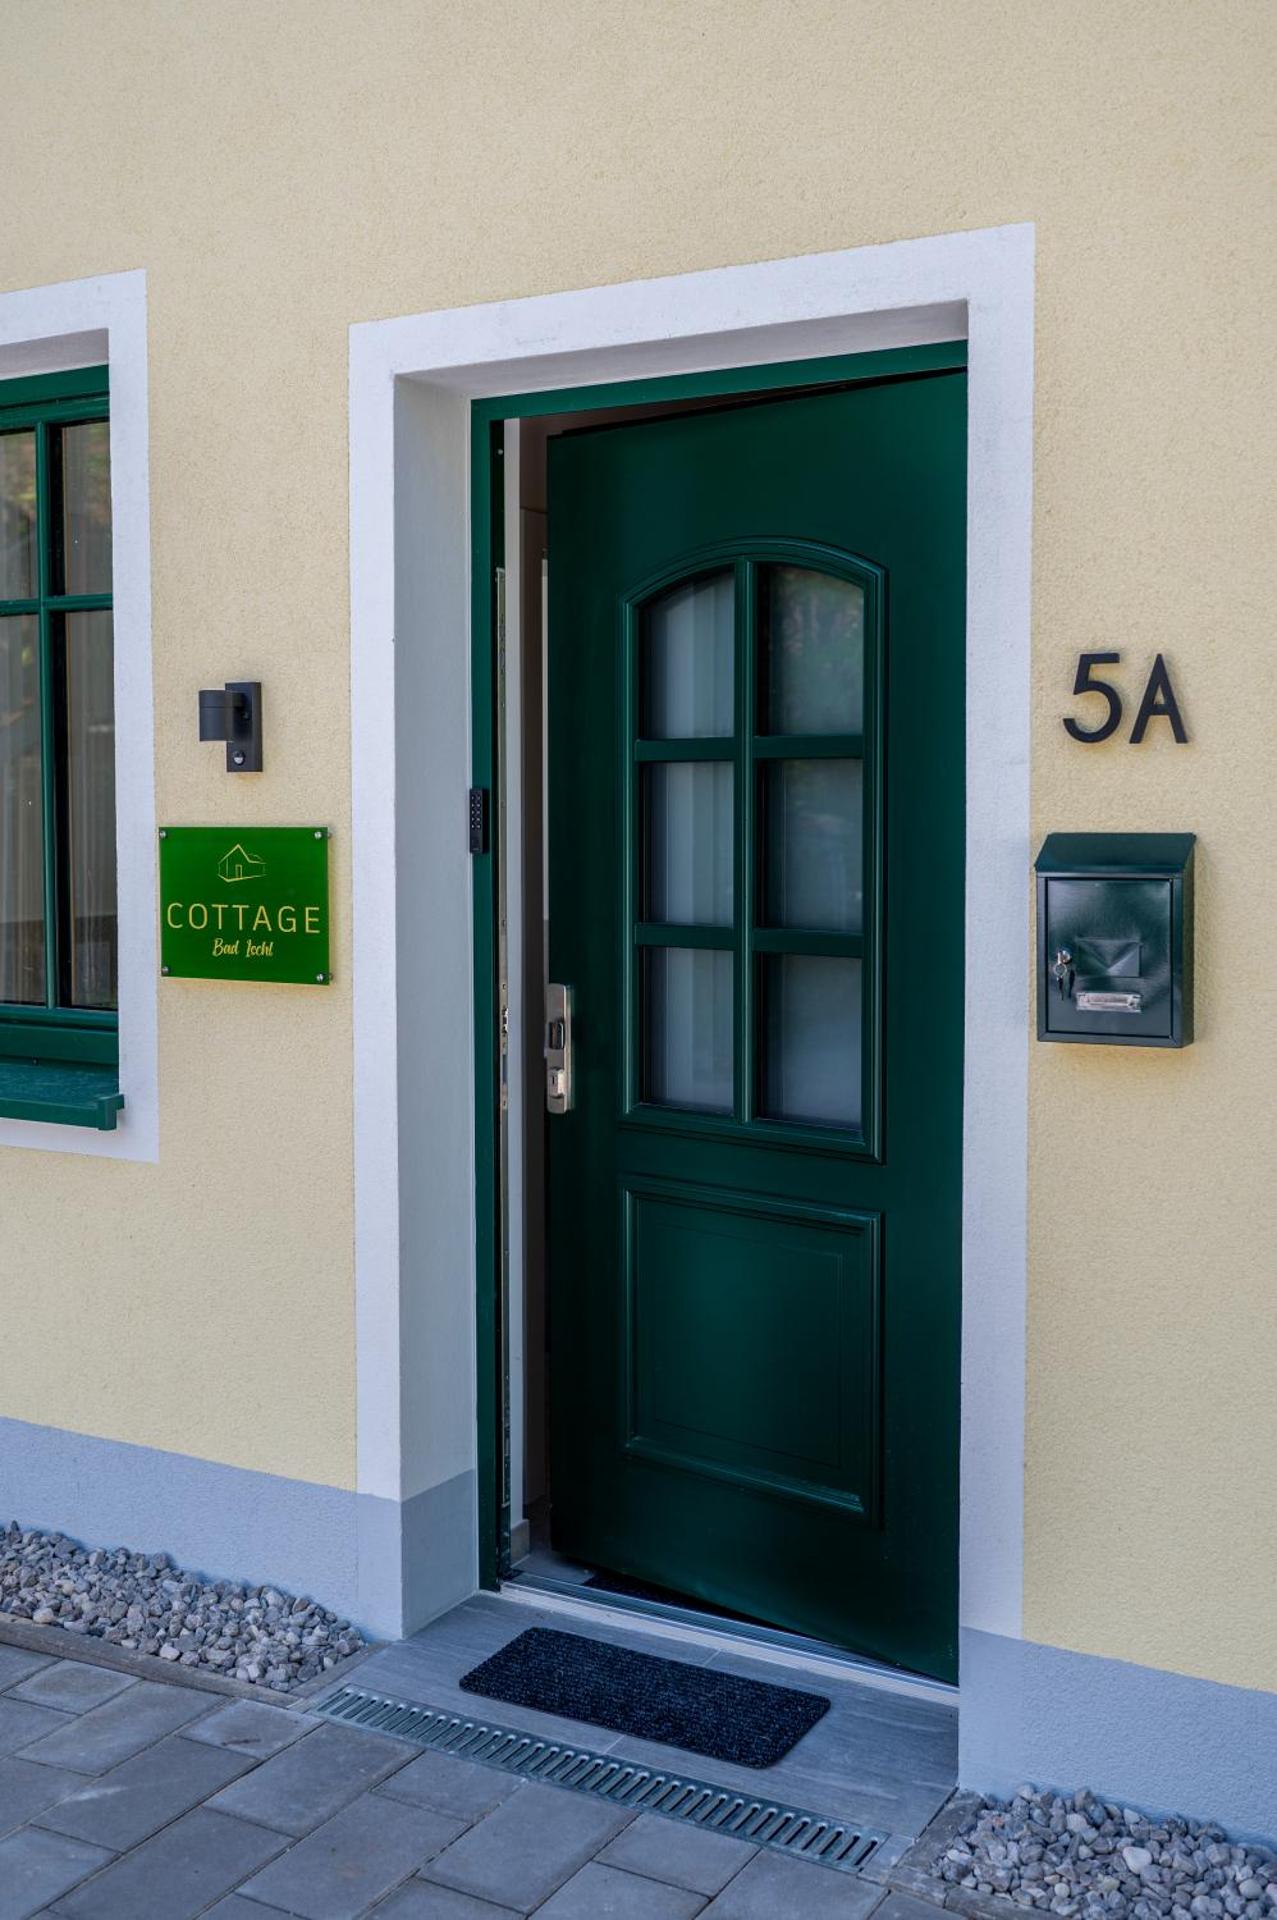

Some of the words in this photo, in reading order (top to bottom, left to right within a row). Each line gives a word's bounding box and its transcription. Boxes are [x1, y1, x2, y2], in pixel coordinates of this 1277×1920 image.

[1062, 652, 1189, 744] 5A
[167, 902, 320, 934] COTTAGE
[212, 937, 240, 957] Bad
